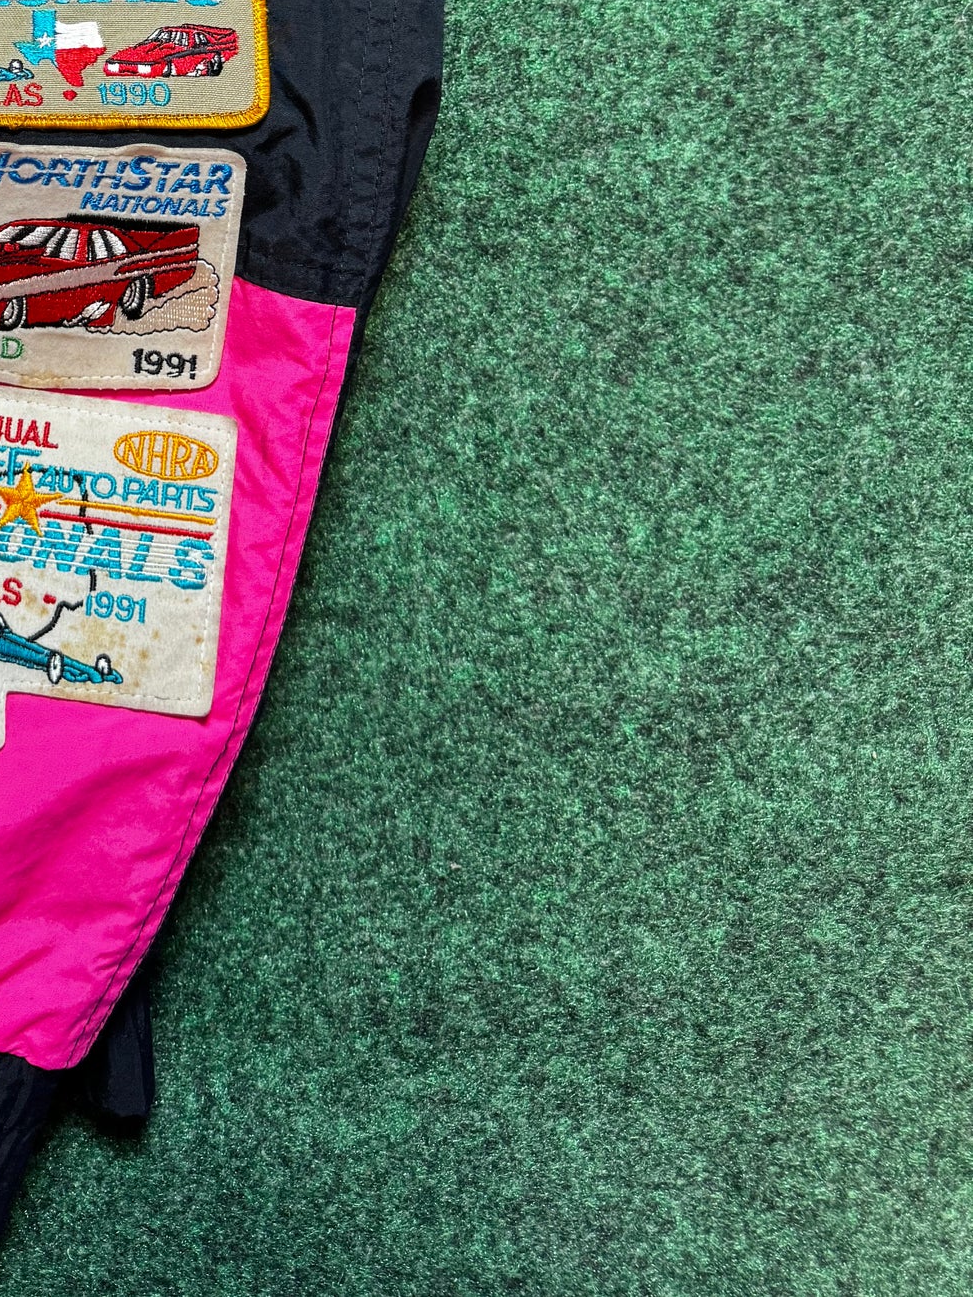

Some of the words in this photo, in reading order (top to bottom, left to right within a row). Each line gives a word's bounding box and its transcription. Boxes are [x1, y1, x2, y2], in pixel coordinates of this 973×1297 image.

[98, 81, 172, 107] 1990
[80, 192, 228, 218] NATIONALS
[132, 348, 198, 380] 1991
[120, 430, 210, 478] NHRA
[122, 477, 219, 514] PARTS
[84, 591, 147, 624] 1991
